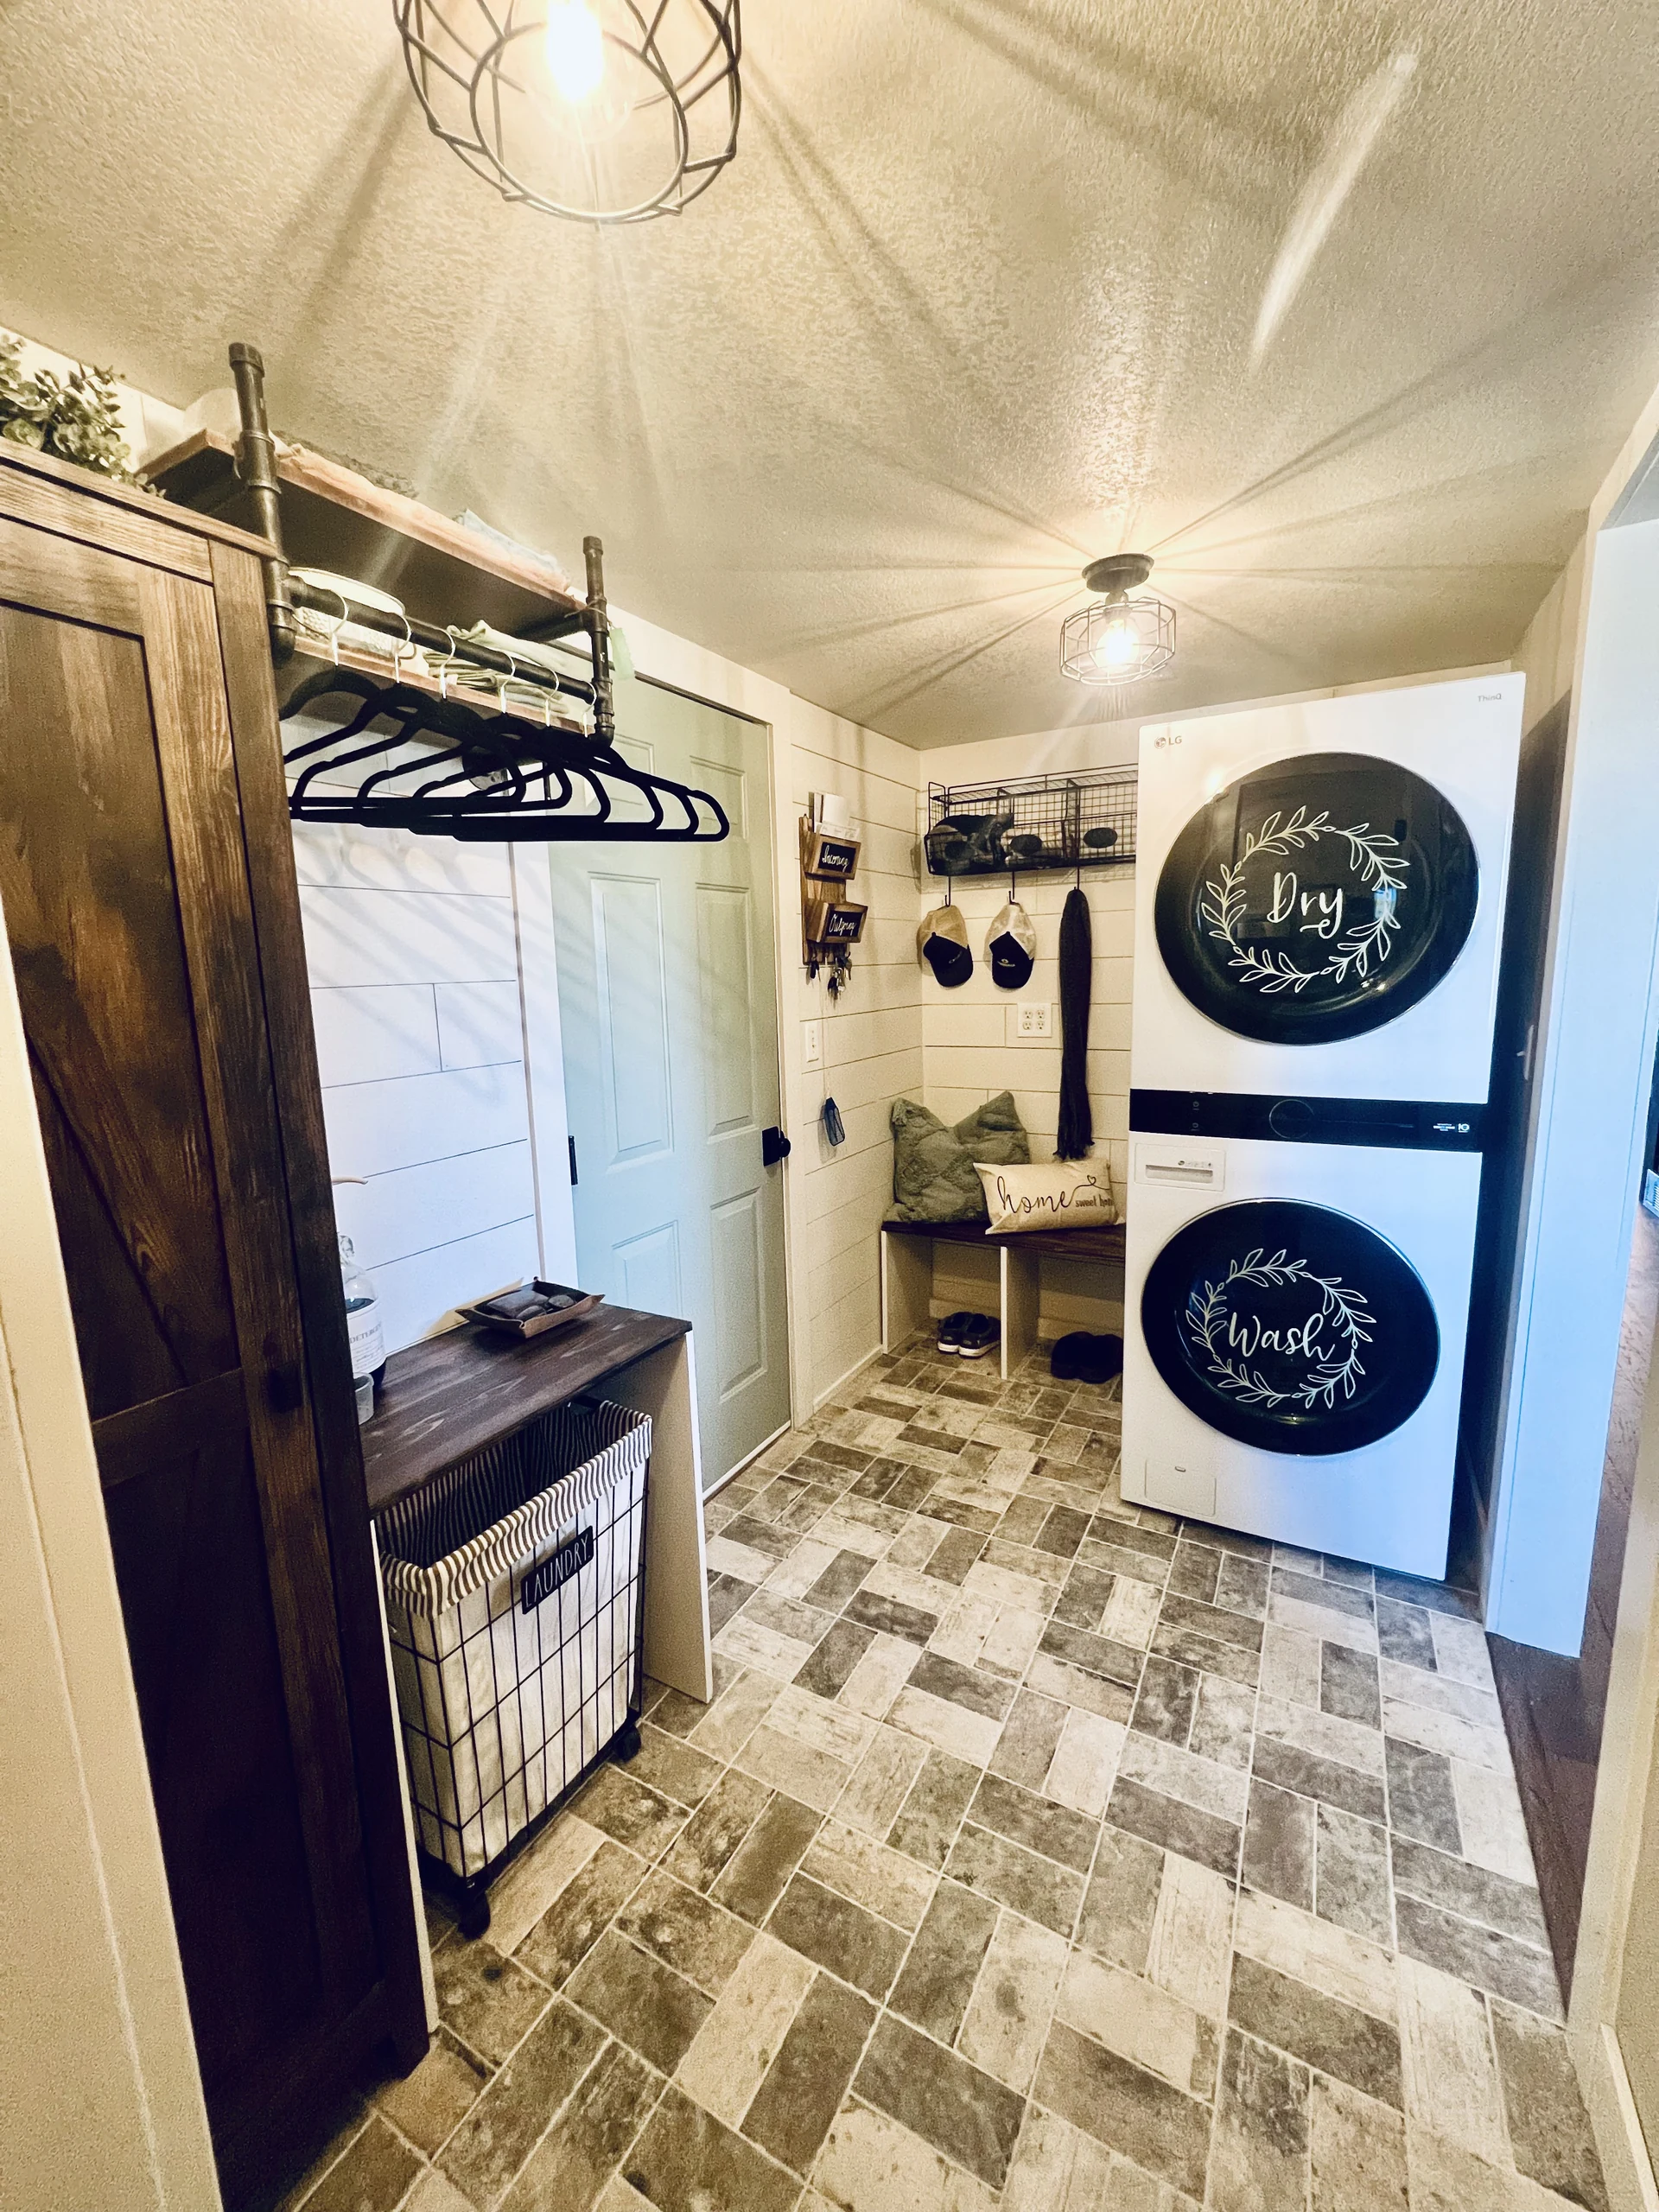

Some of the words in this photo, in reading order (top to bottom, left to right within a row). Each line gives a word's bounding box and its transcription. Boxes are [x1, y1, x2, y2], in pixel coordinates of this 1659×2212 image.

[1478, 693, 1502, 702] ThinQ
[1168, 735, 1182, 746] LG
[1266, 872, 1343, 938] Dry
[997, 1175, 1072, 1214] home
[1075, 1195, 1097, 1208] sweet
[1226, 1312, 1336, 1361] Wash
